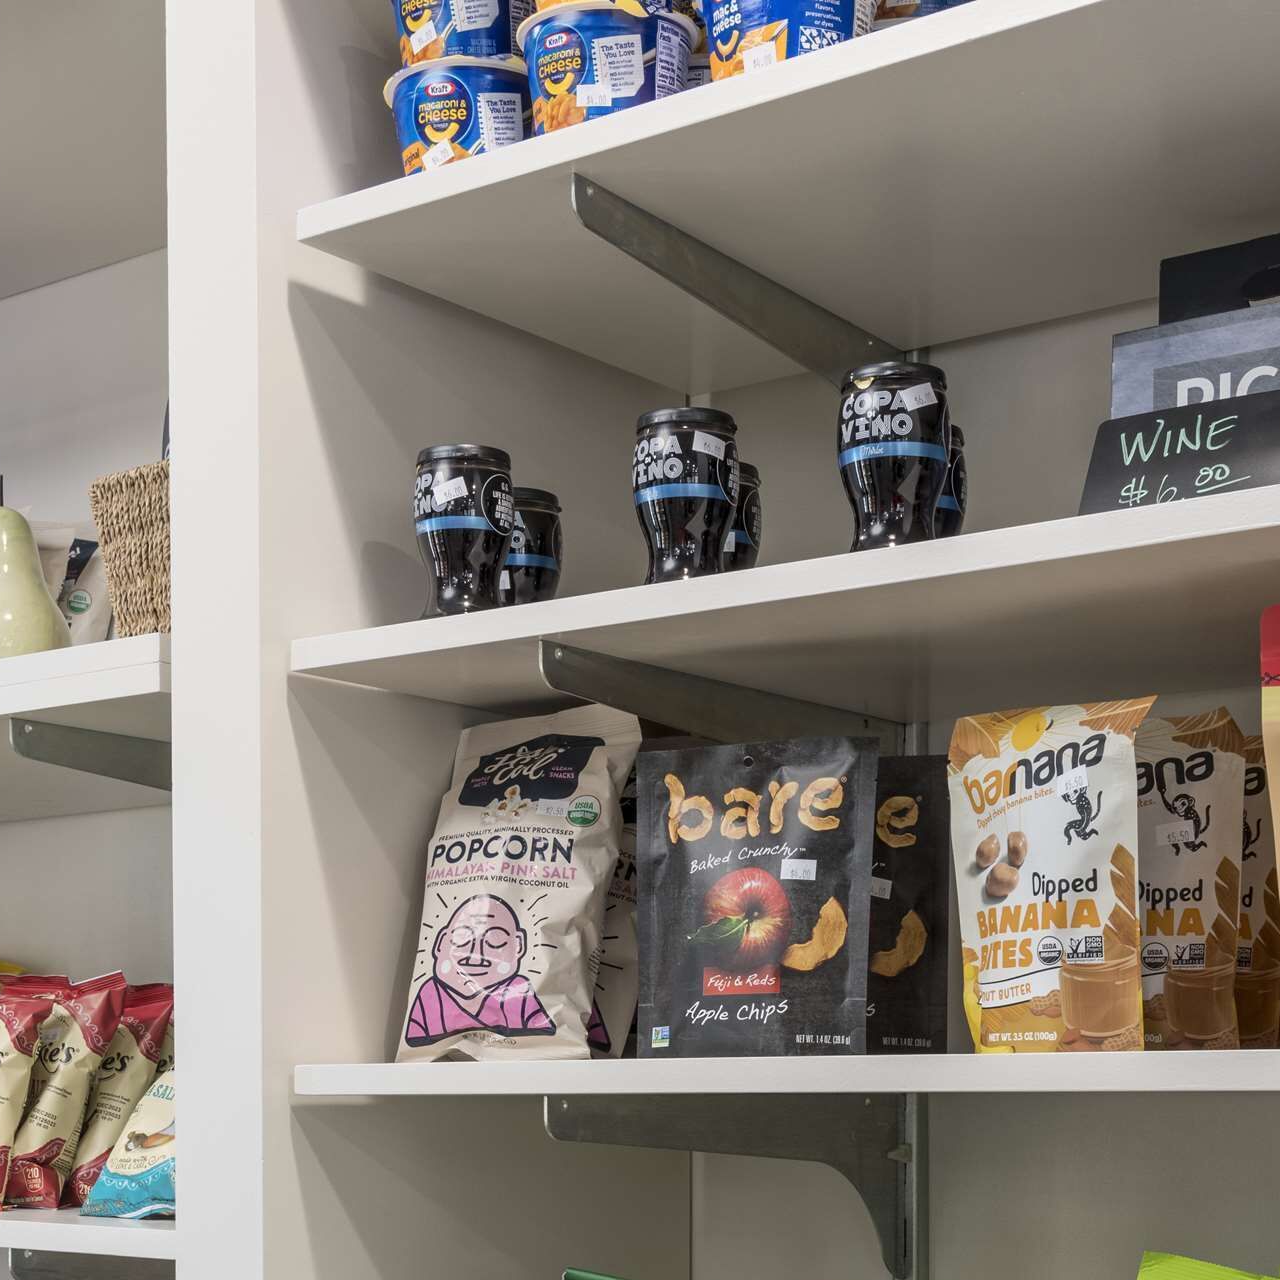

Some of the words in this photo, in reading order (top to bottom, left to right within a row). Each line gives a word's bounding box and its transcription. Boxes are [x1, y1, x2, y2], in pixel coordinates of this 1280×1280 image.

[431, 85, 448, 95] Kraft
[418, 100, 459, 111] macaroni
[1120, 414, 1239, 466] WINE
[663, 773, 844, 844] bare
[439, 831, 465, 841] PREMIUM
[494, 825, 530, 835] MINIMALLY
[532, 827, 574, 836] PROCESSED
[431, 834, 575, 868] POPCORN
[689, 851, 730, 874] Baked
[738, 842, 799, 859] Crunchy
[491, 875, 517, 884] VIRGIN
[518, 879, 556, 888] COCONUT
[501, 862, 538, 877] PINK
[543, 866, 577, 880] SALT
[1031, 868, 1098, 903] Dipped
[977, 897, 1102, 939] BANANA
[977, 937, 1033, 973] BITES
[707, 974, 732, 991] Fuji
[746, 975, 777, 986] Reds
[685, 1000, 729, 1025] Apple
[736, 1000, 788, 1024] Chips
[27, 1167, 39, 1178] 210
